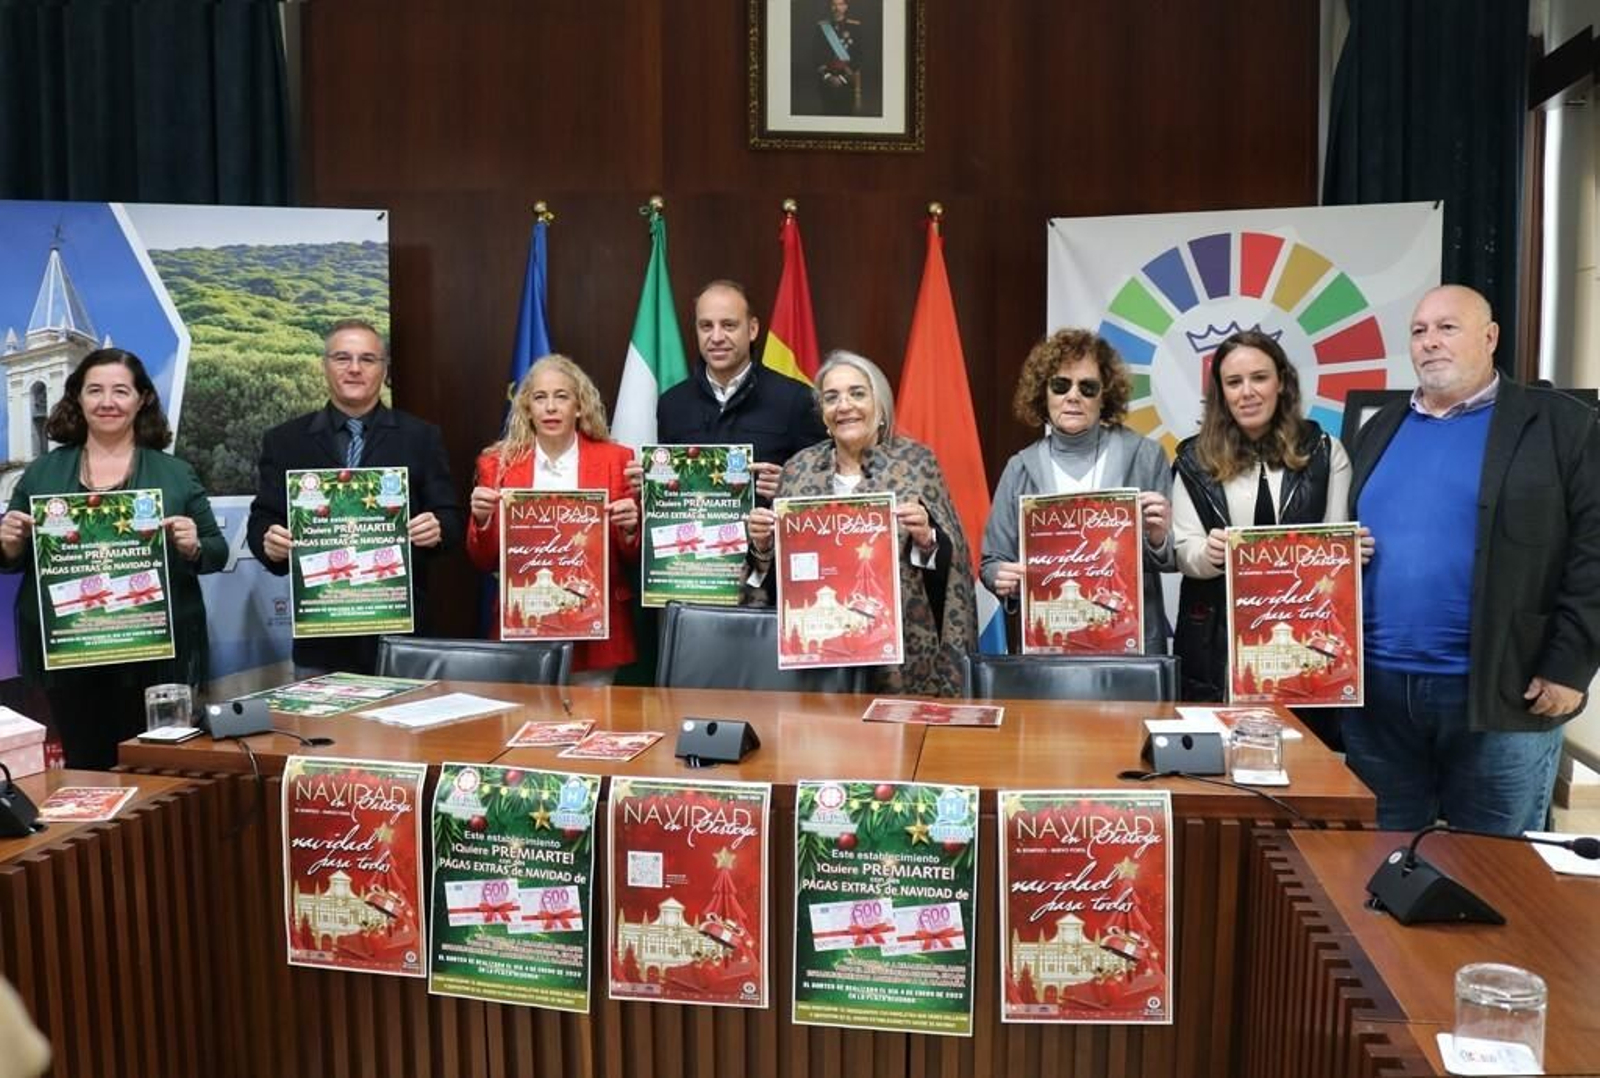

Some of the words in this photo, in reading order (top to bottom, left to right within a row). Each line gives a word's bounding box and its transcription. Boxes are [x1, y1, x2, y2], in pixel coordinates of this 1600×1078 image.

[511, 505, 597, 520] NAVIDAD
[647, 511, 669, 519] PAGAS
[786, 512, 883, 533] NAVIDAD
[1032, 507, 1128, 527] NAVIDAD
[293, 538, 319, 547] PAGAS
[1239, 544, 1347, 565] NAVIDAD
[42, 565, 69, 575] PAGAS
[114, 560, 150, 570] NAVIDAD
[296, 780, 406, 804] NAVIDAD
[624, 802, 752, 828] NAVIDAD
[292, 824, 378, 850] navidad
[1017, 816, 1154, 839] NAVIDAD
[464, 830, 484, 840] Este
[487, 834, 560, 848] establecimiento
[307, 848, 352, 875] para
[492, 844, 574, 864] PREMIARTE!
[832, 850, 854, 859] Este
[857, 851, 940, 864] establecimiento
[439, 858, 470, 870] PAGAS
[474, 862, 508, 876] EXTRAS
[511, 866, 522, 876] de
[526, 870, 572, 882] NAVIDAD
[574, 872, 586, 884] de
[862, 864, 955, 880] PREMIARTE!
[1012, 860, 1121, 892] navidad
[484, 882, 510, 897] 500
[544, 888, 569, 903] 500
[802, 879, 838, 891] PAGAS
[842, 882, 880, 894] EXTRAS
[885, 886, 898, 896] de
[900, 886, 952, 899] NAVIDAD
[956, 889, 969, 900] de
[854, 902, 882, 917] 500
[921, 906, 950, 923] 500
[1030, 890, 1085, 922] para
